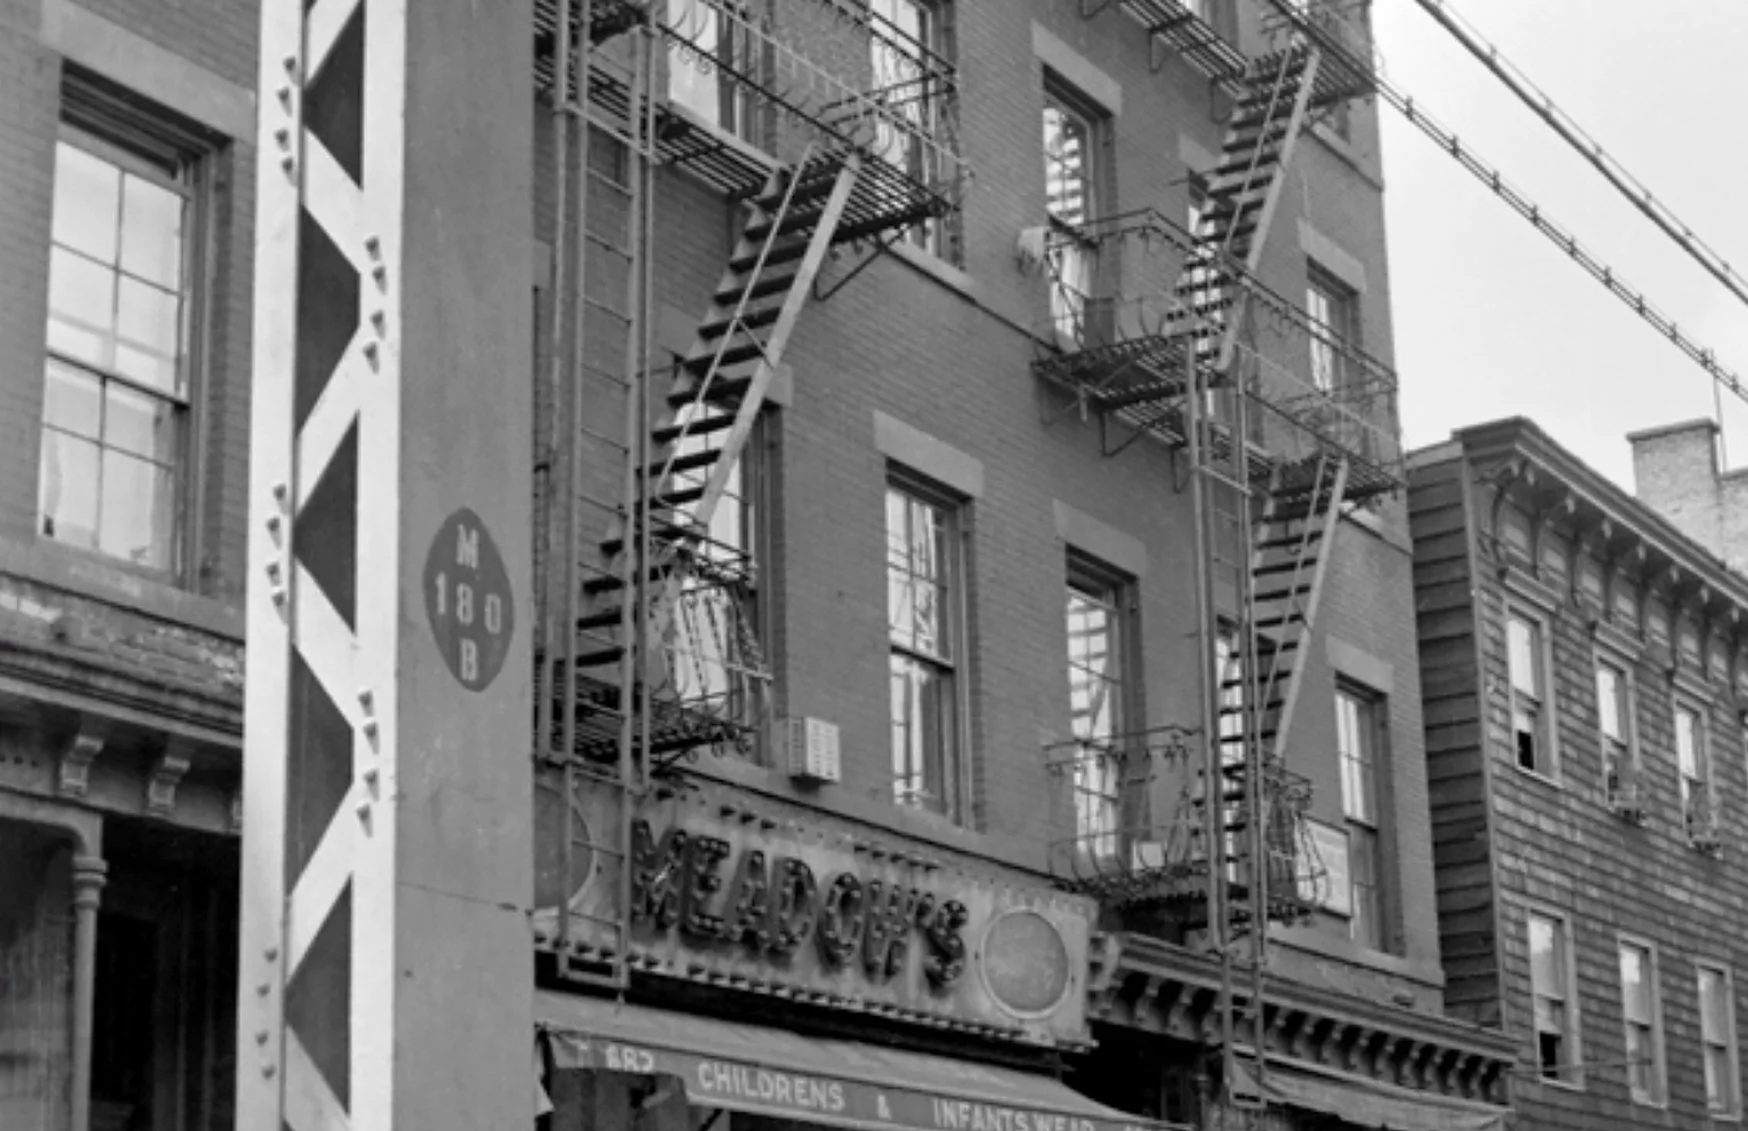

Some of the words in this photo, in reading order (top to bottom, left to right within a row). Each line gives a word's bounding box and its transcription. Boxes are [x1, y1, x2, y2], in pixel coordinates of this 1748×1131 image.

[456, 523, 480, 570] M
[435, 571, 501, 635] 180
[699, 1061, 845, 1111] CHILDRENS
